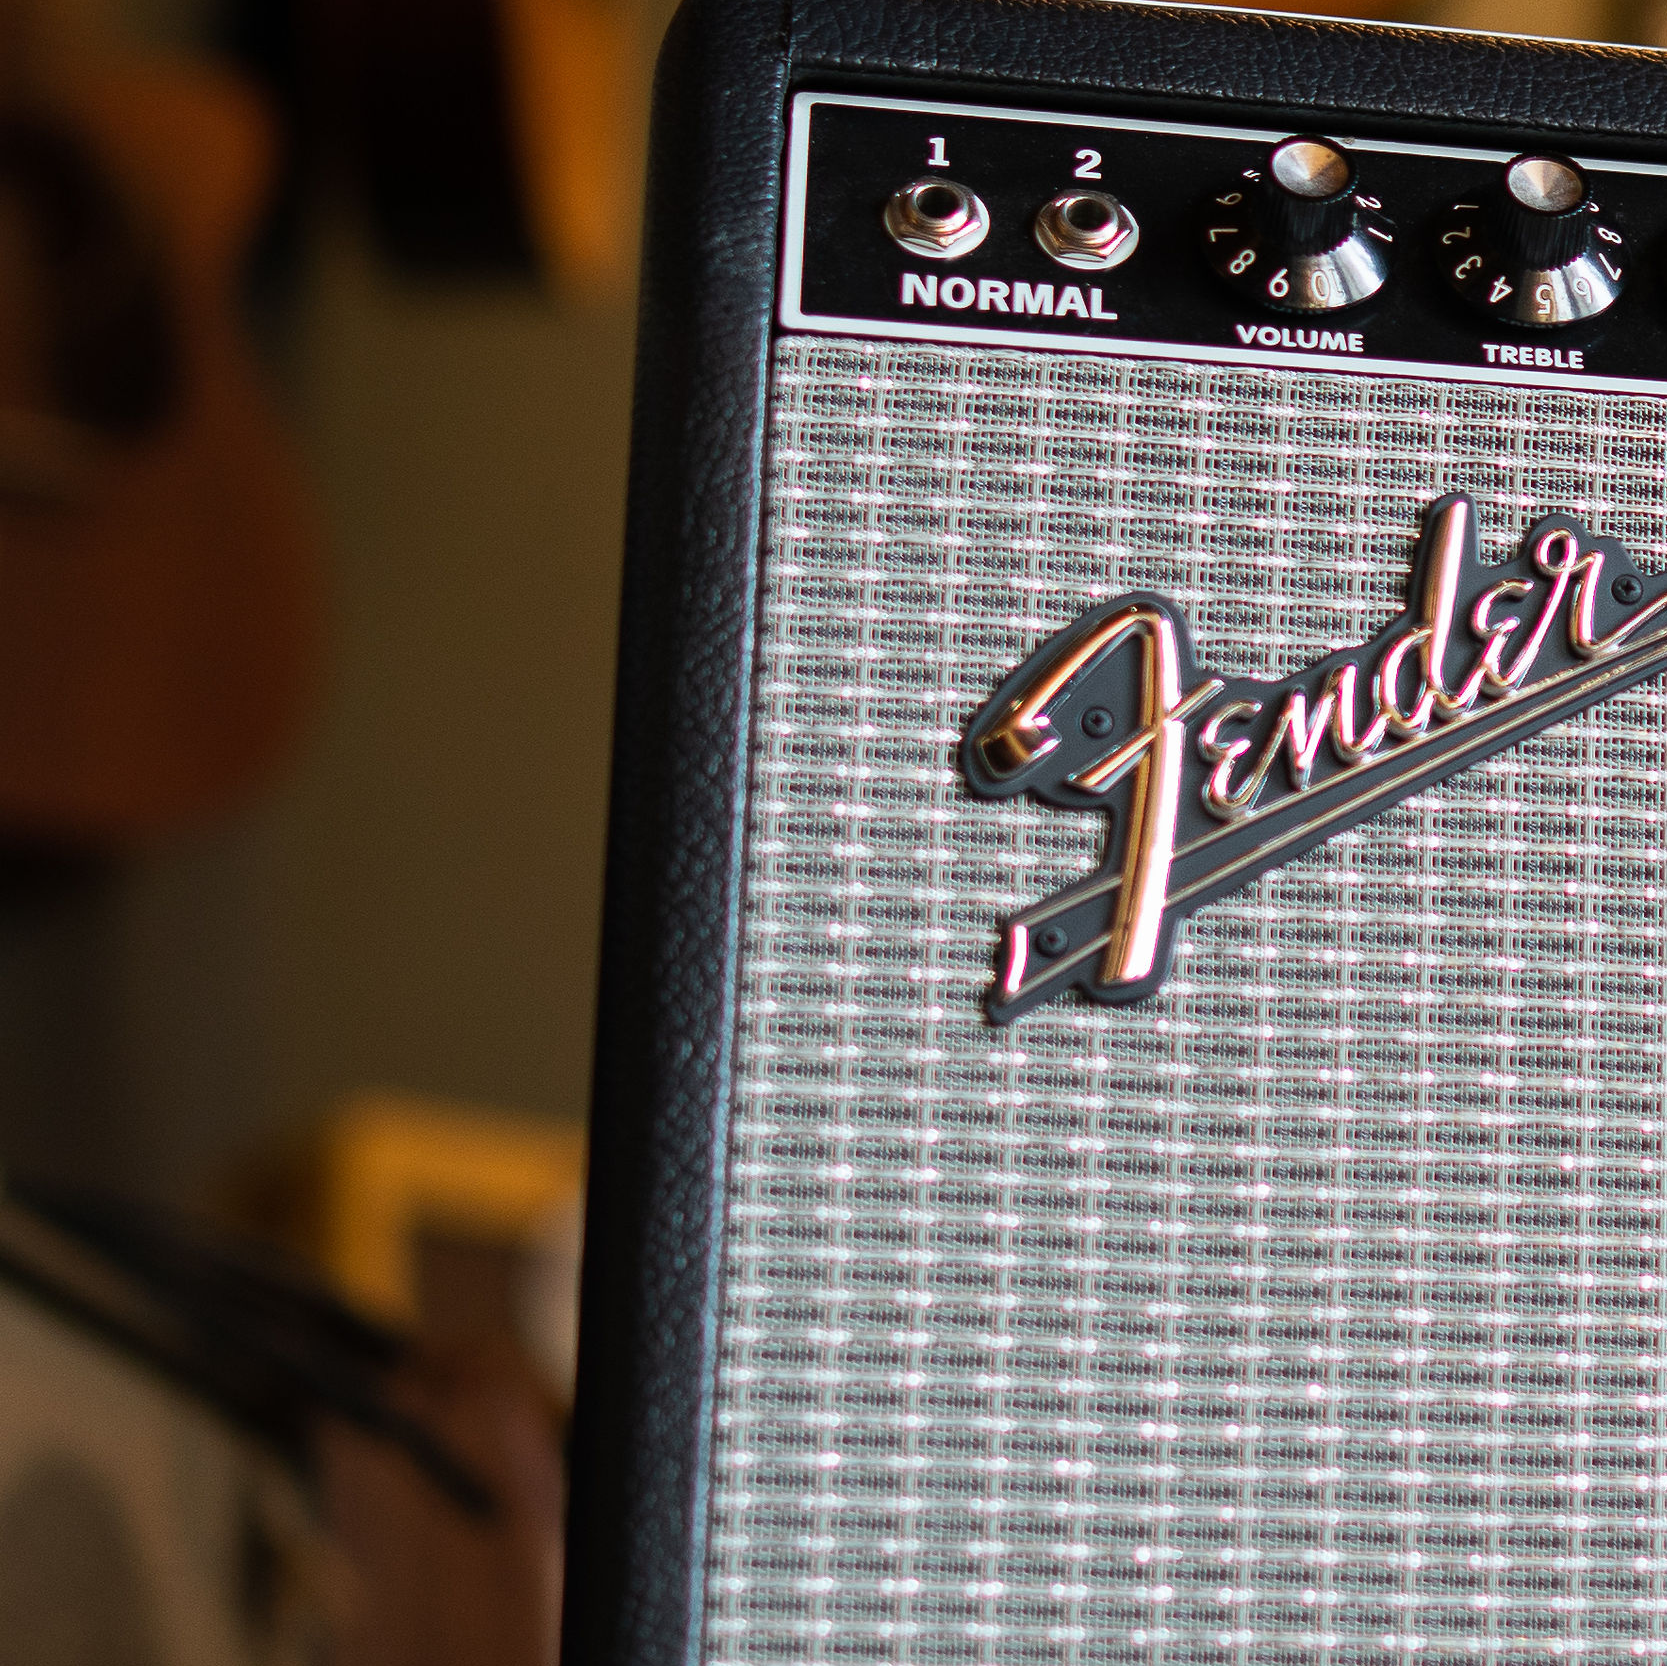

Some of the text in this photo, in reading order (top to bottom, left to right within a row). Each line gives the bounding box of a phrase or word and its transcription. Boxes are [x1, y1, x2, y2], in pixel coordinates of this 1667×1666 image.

[928, 137, 950, 168] 1
[1075, 149, 1103, 180] 2
[1355, 195, 1382, 210] 2
[1209, 228, 1239, 243] 7
[1367, 226, 1393, 243] 1
[1442, 226, 1471, 245] 2
[1598, 227, 1622, 244] 8
[1229, 249, 1256, 275] 8
[1455, 255, 1483, 280] 3
[1598, 252, 1623, 281] 7
[902, 273, 1118, 321] NORMAL
[1488, 275, 1513, 304] 4
[1535, 283, 1552, 315] 5
[1236, 324, 1364, 352] VOLUME
[1482, 343, 1584, 369] TREBLE
